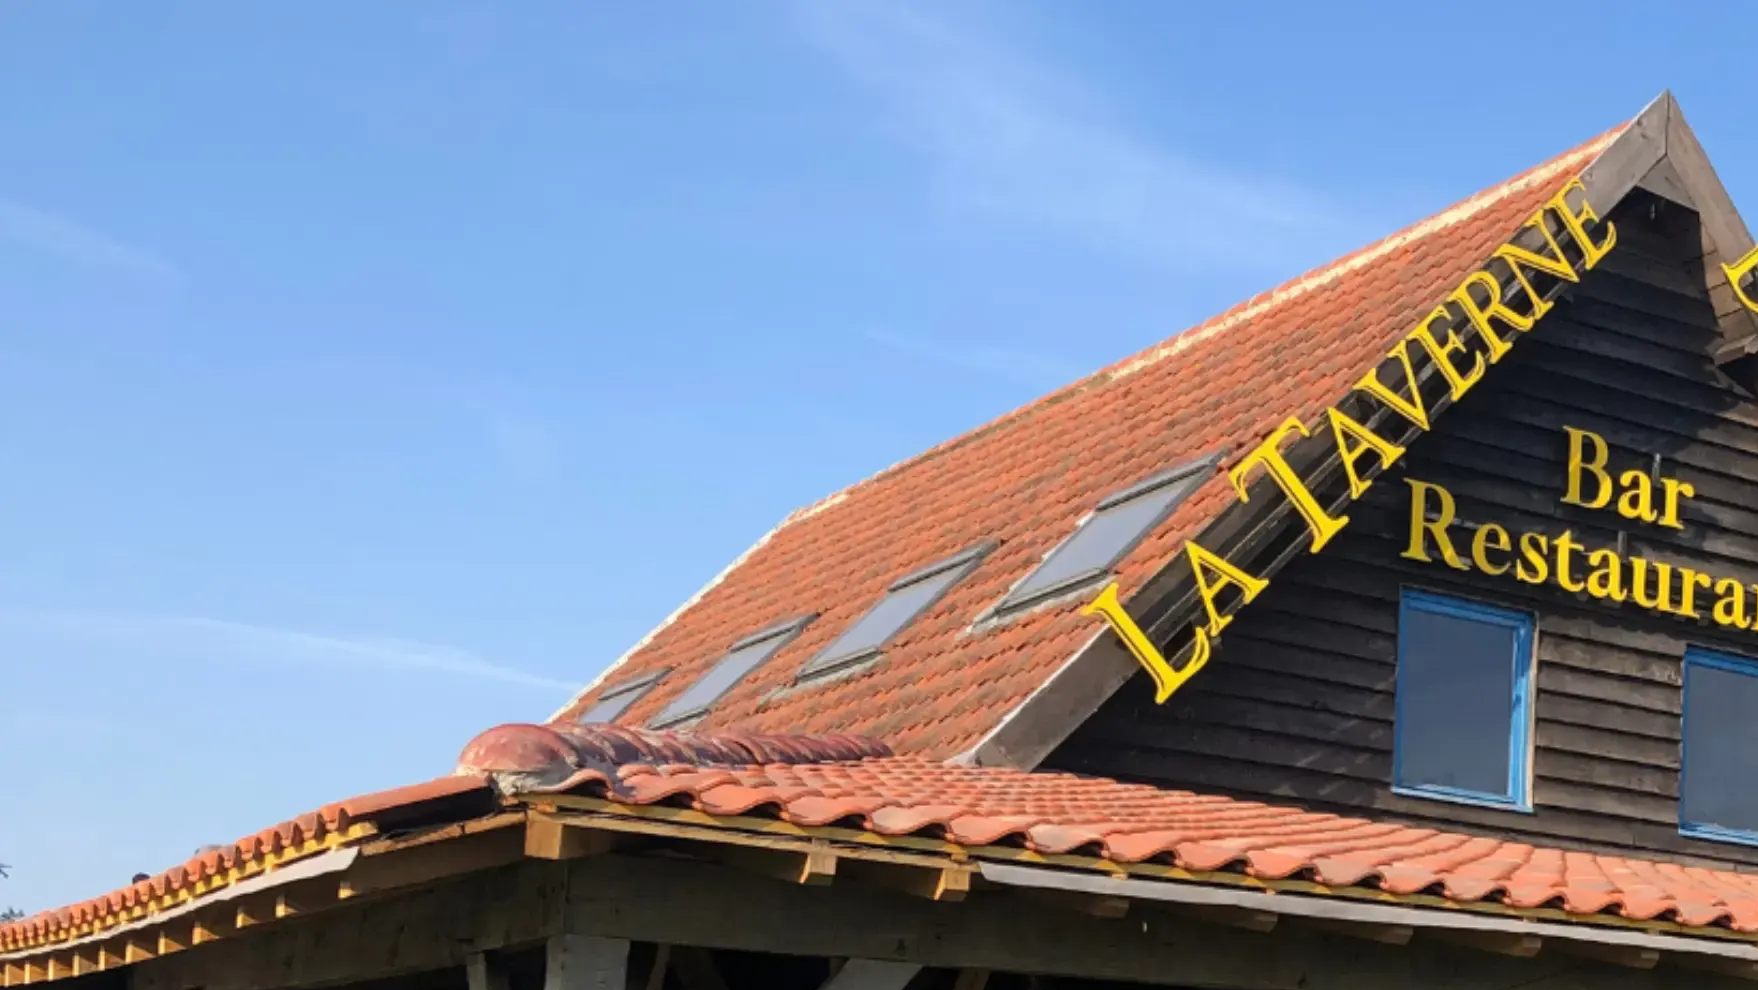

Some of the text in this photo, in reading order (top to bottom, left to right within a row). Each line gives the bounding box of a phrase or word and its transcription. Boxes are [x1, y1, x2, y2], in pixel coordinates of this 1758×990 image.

[1081, 177, 1618, 705] LA TAVERNE
[1559, 424, 1696, 531] Bar
